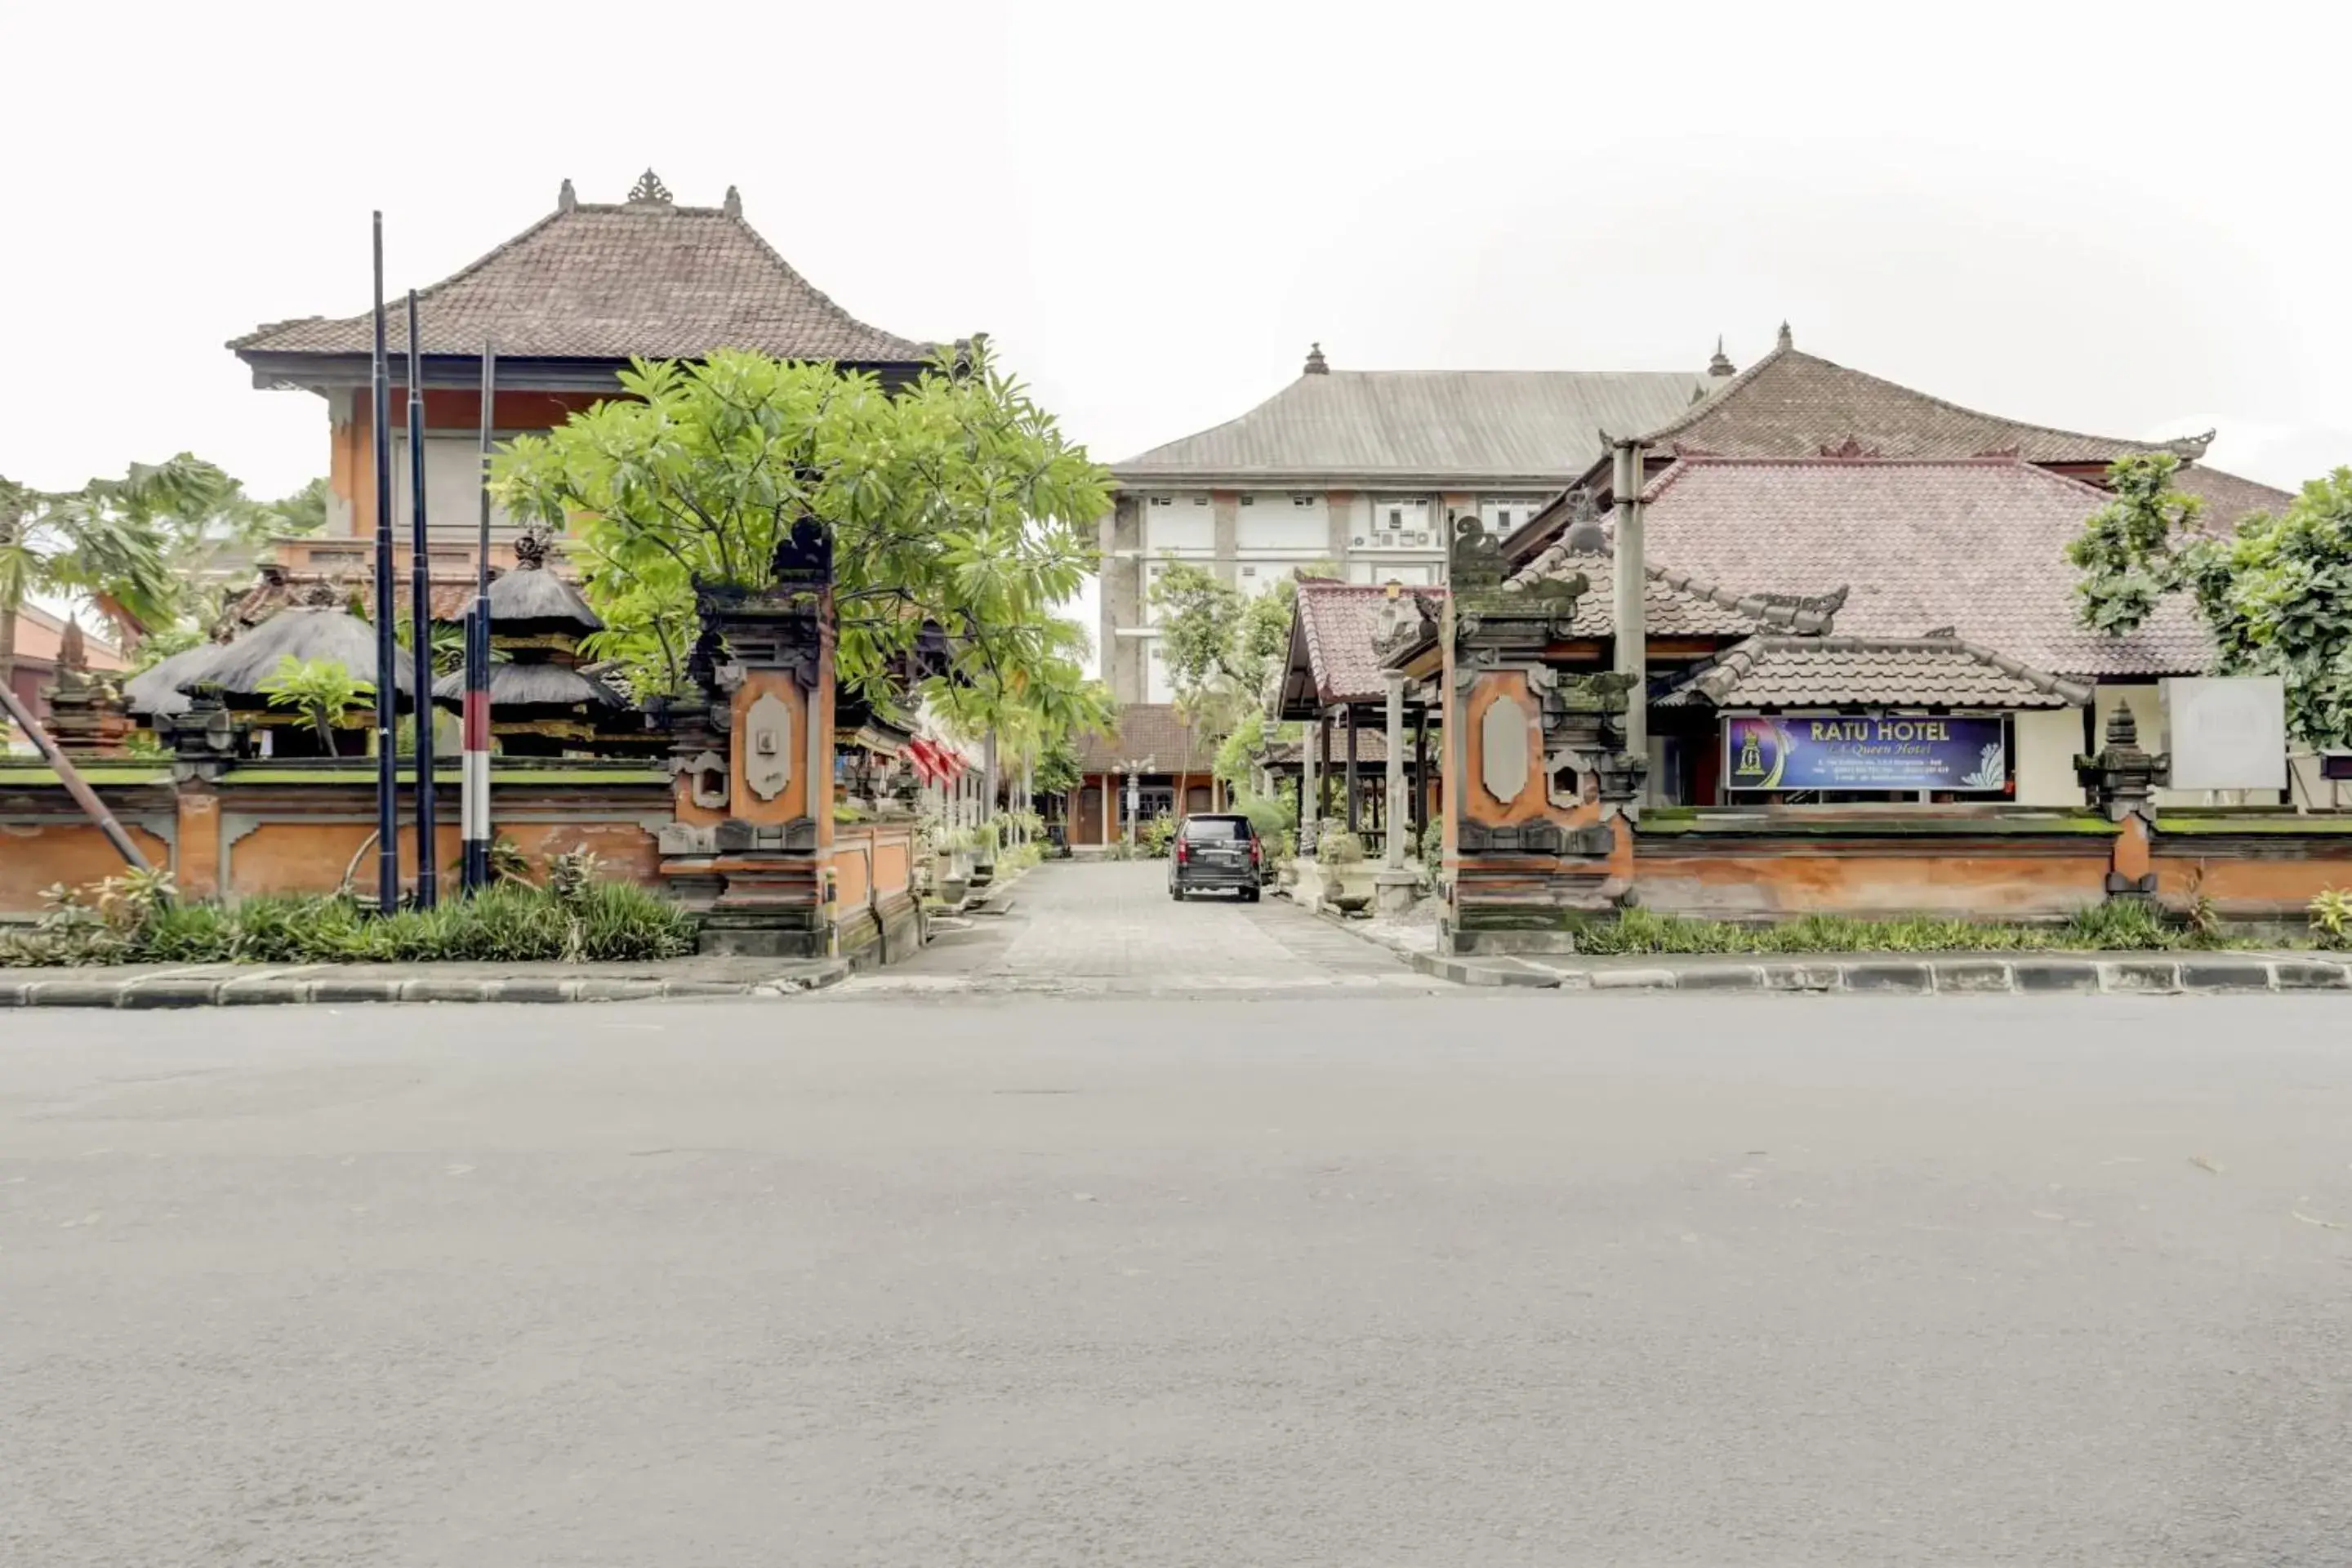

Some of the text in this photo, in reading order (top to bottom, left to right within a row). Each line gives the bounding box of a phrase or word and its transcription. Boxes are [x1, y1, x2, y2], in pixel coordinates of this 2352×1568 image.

[1811, 722, 1950, 742] RATU HOTEL
[1852, 743, 1891, 758] Queen
[1894, 742, 1931, 755] Hotel
